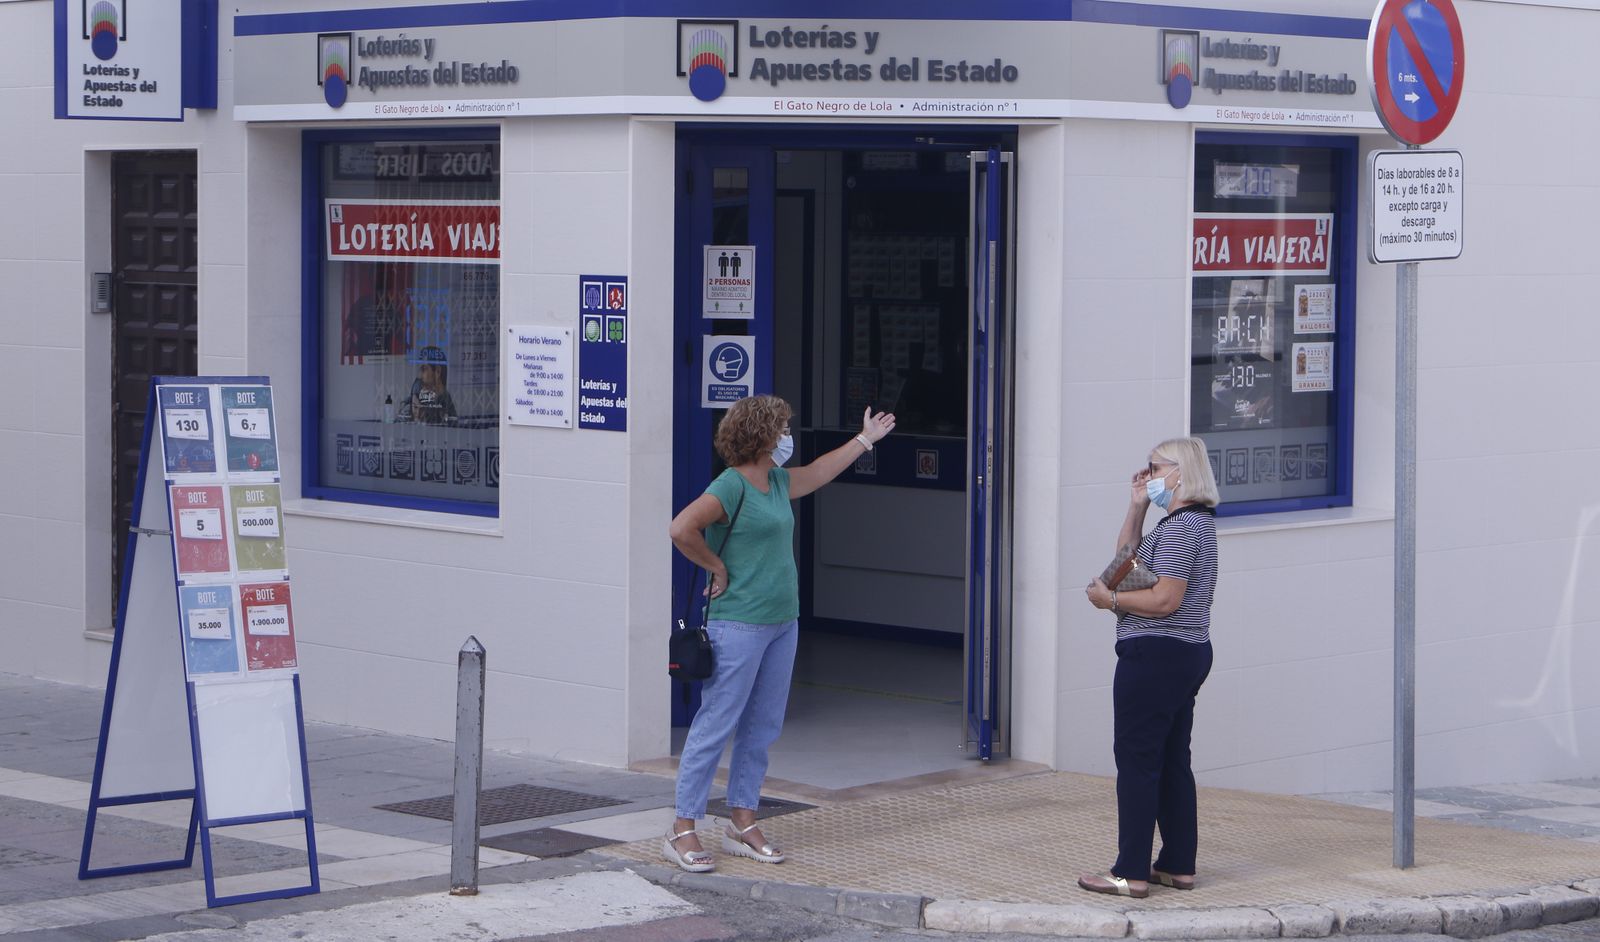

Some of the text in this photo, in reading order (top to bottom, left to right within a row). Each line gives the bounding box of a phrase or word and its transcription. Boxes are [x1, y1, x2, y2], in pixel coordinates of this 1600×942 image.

[749, 25, 879, 55] Loterías y
[357, 35, 435, 59] Loterías y
[1202, 36, 1280, 67] Loterías y
[83, 63, 140, 80] Loterías y
[358, 59, 519, 91] Apuestas del Estado
[749, 57, 1018, 86] Apuestas del Estado
[1398, 72, 1418, 82] 6 mts.
[84, 79, 157, 95] Apuestas del
[1203, 67, 1357, 95] Apuestas del Estado
[83, 94, 123, 108] Estado
[774, 101, 783, 110] El
[786, 101, 813, 111] Gato
[816, 101, 850, 113] Negro
[853, 102, 867, 111] de
[870, 101, 893, 111] Lola
[912, 102, 994, 112] Administración
[375, 105, 381, 113] El
[382, 105, 398, 113] Gato
[400, 104, 419, 115] Negro
[420, 104, 429, 113] de
[431, 103, 444, 113] Lola
[455, 102, 505, 112] Administración
[1216, 109, 1222, 118] El
[1224, 110, 1239, 119] Gato
[1241, 111, 1260, 121] Negro
[1262, 112, 1270, 120] de
[1271, 112, 1284, 120] Lola
[1396, 167, 1435, 179] laborables
[1437, 167, 1446, 178] de
[1448, 166, 1453, 178] 8
[1455, 168, 1459, 178] a
[1382, 182, 1455, 198] 14 h. y de 16 a 20 h.
[1389, 200, 1448, 213] excepto carga y
[1401, 216, 1436, 229] descarga
[339, 212, 500, 251] LOTERÍA VIAJ
[1193, 225, 1325, 265] RÍA VIAJERA
[1380, 230, 1457, 247] (máximo 30 minutos)
[1299, 323, 1331, 331] MALLORCA
[519, 336, 562, 345] Horario Verano
[1232, 365, 1255, 388] 130
[581, 379, 617, 393] Loterías y
[175, 392, 194, 404] BOTE
[237, 392, 256, 403] BOTE
[581, 395, 628, 409] Apuestas del
[580, 412, 605, 424] Estado
[176, 420, 199, 431] 130
[188, 491, 207, 503] BOTE
[246, 490, 265, 502] BOTE
[197, 520, 204, 531] 5
[242, 518, 274, 527] 500.000
[197, 591, 217, 603] BOTE
[256, 588, 275, 600] BOTE
[198, 621, 222, 629] 35.000
[251, 618, 285, 626] 1.900.000
